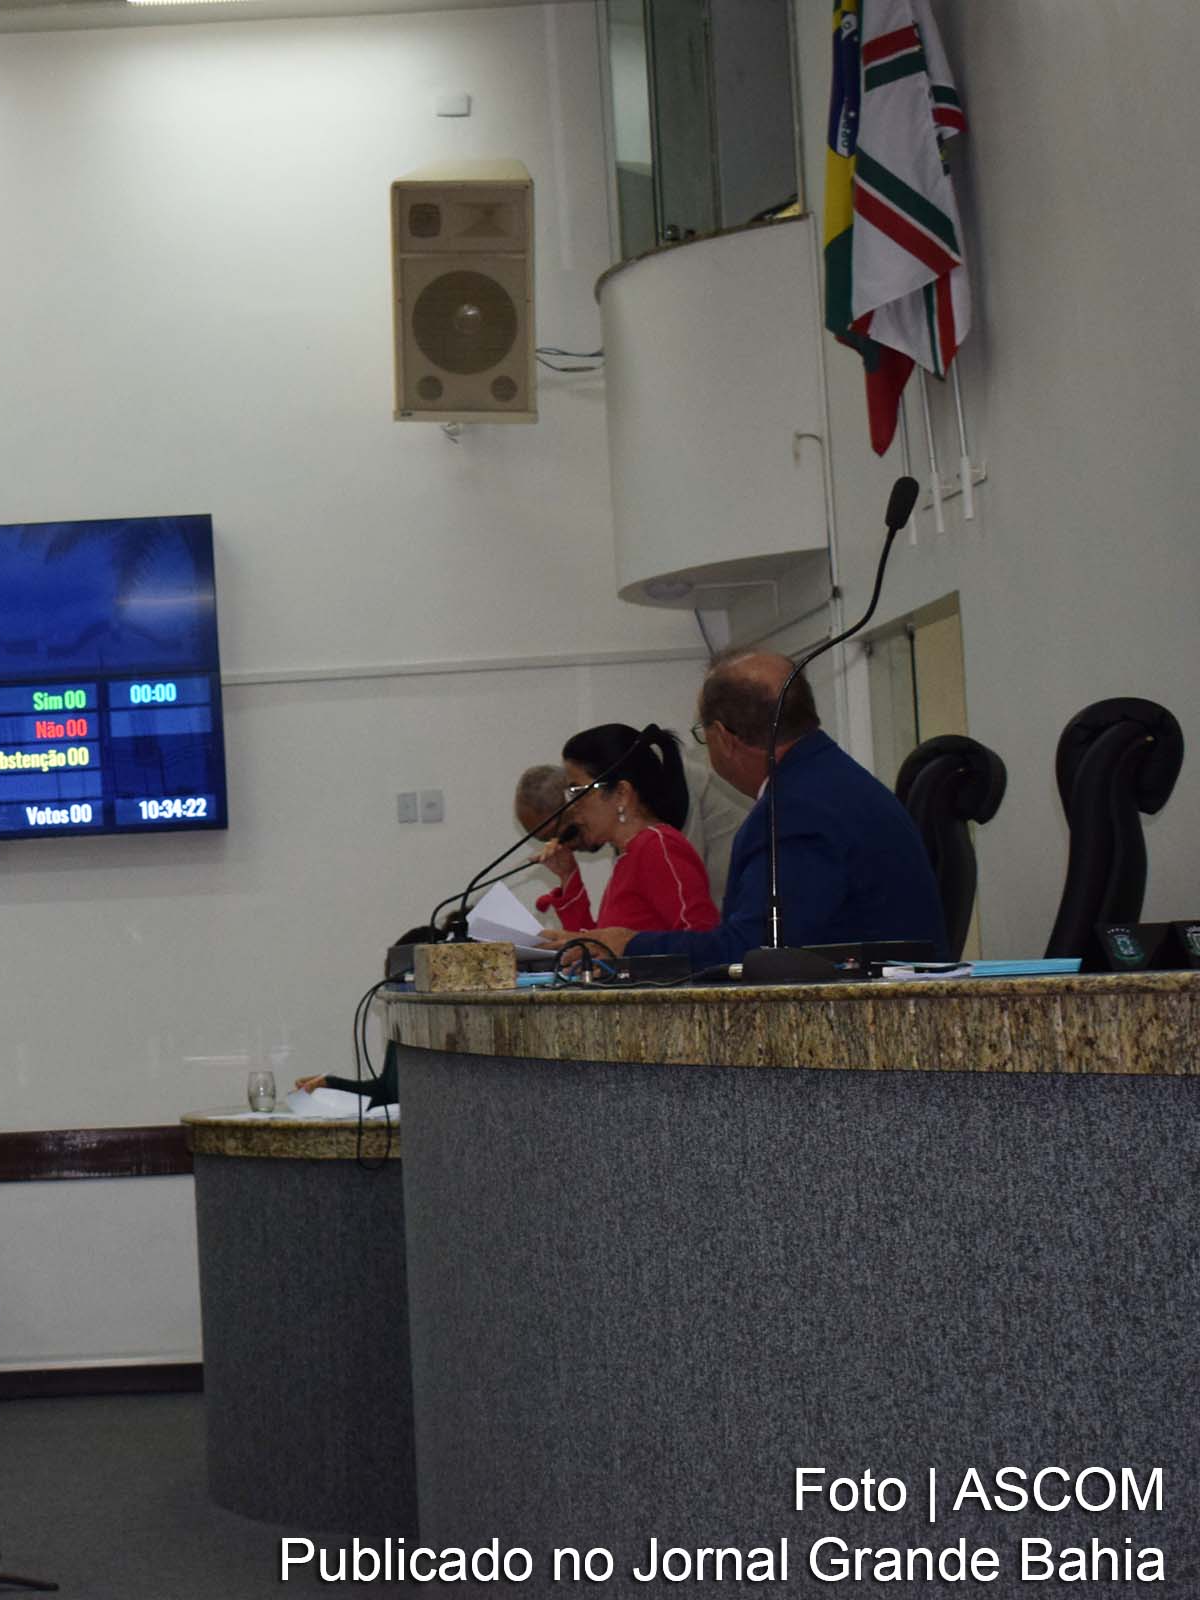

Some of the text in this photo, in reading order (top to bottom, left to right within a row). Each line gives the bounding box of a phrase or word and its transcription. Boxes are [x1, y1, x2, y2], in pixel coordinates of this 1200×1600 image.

[32, 689, 88, 712] Sim 00
[129, 683, 177, 704] 00:00
[35, 718, 88, 739] Não 00
[67, 747, 90, 767] 00
[25, 804, 93, 826] Votos 00
[138, 797, 208, 820] 10:34:22
